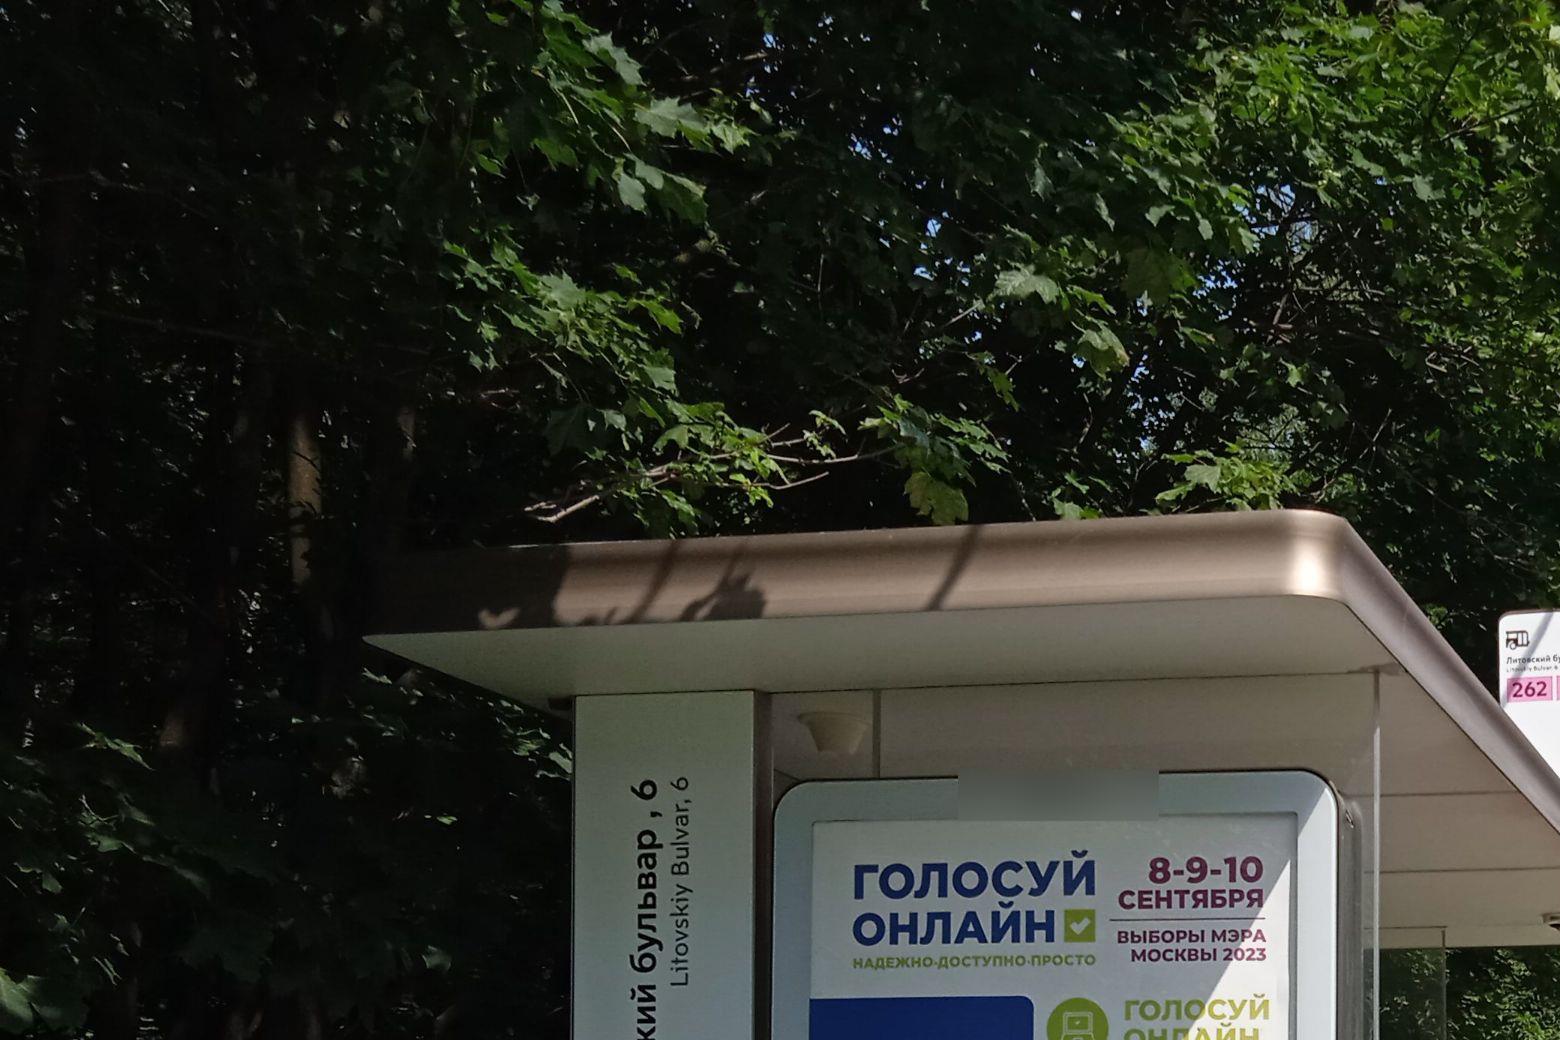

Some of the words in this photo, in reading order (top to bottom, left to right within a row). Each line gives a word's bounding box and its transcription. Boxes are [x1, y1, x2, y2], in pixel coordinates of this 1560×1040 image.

[1507, 656, 1550, 664] Литовский
[1512, 682, 1546, 698] 262
[631, 779, 657, 800] 6
[671, 776, 689, 791] 6
[671, 799, 693, 876] Bulvar,
[853, 850, 1096, 899] ГОЛОСУЙ
[1149, 856, 1264, 885] 8-9-10
[1118, 889, 1264, 910] СЕНТЯБРЯ
[853, 902, 1055, 946] ОНЛАЙН
[670, 884, 693, 987] Litovskiy
[1117, 928, 1207, 945] ВЫБОРЫ
[1213, 927, 1266, 944] МЭРА
[1131, 947, 1217, 963] МОСКВЫ
[1222, 946, 1267, 963] 2023
[1123, 993, 1270, 1021] ГОЛОСУЙ
